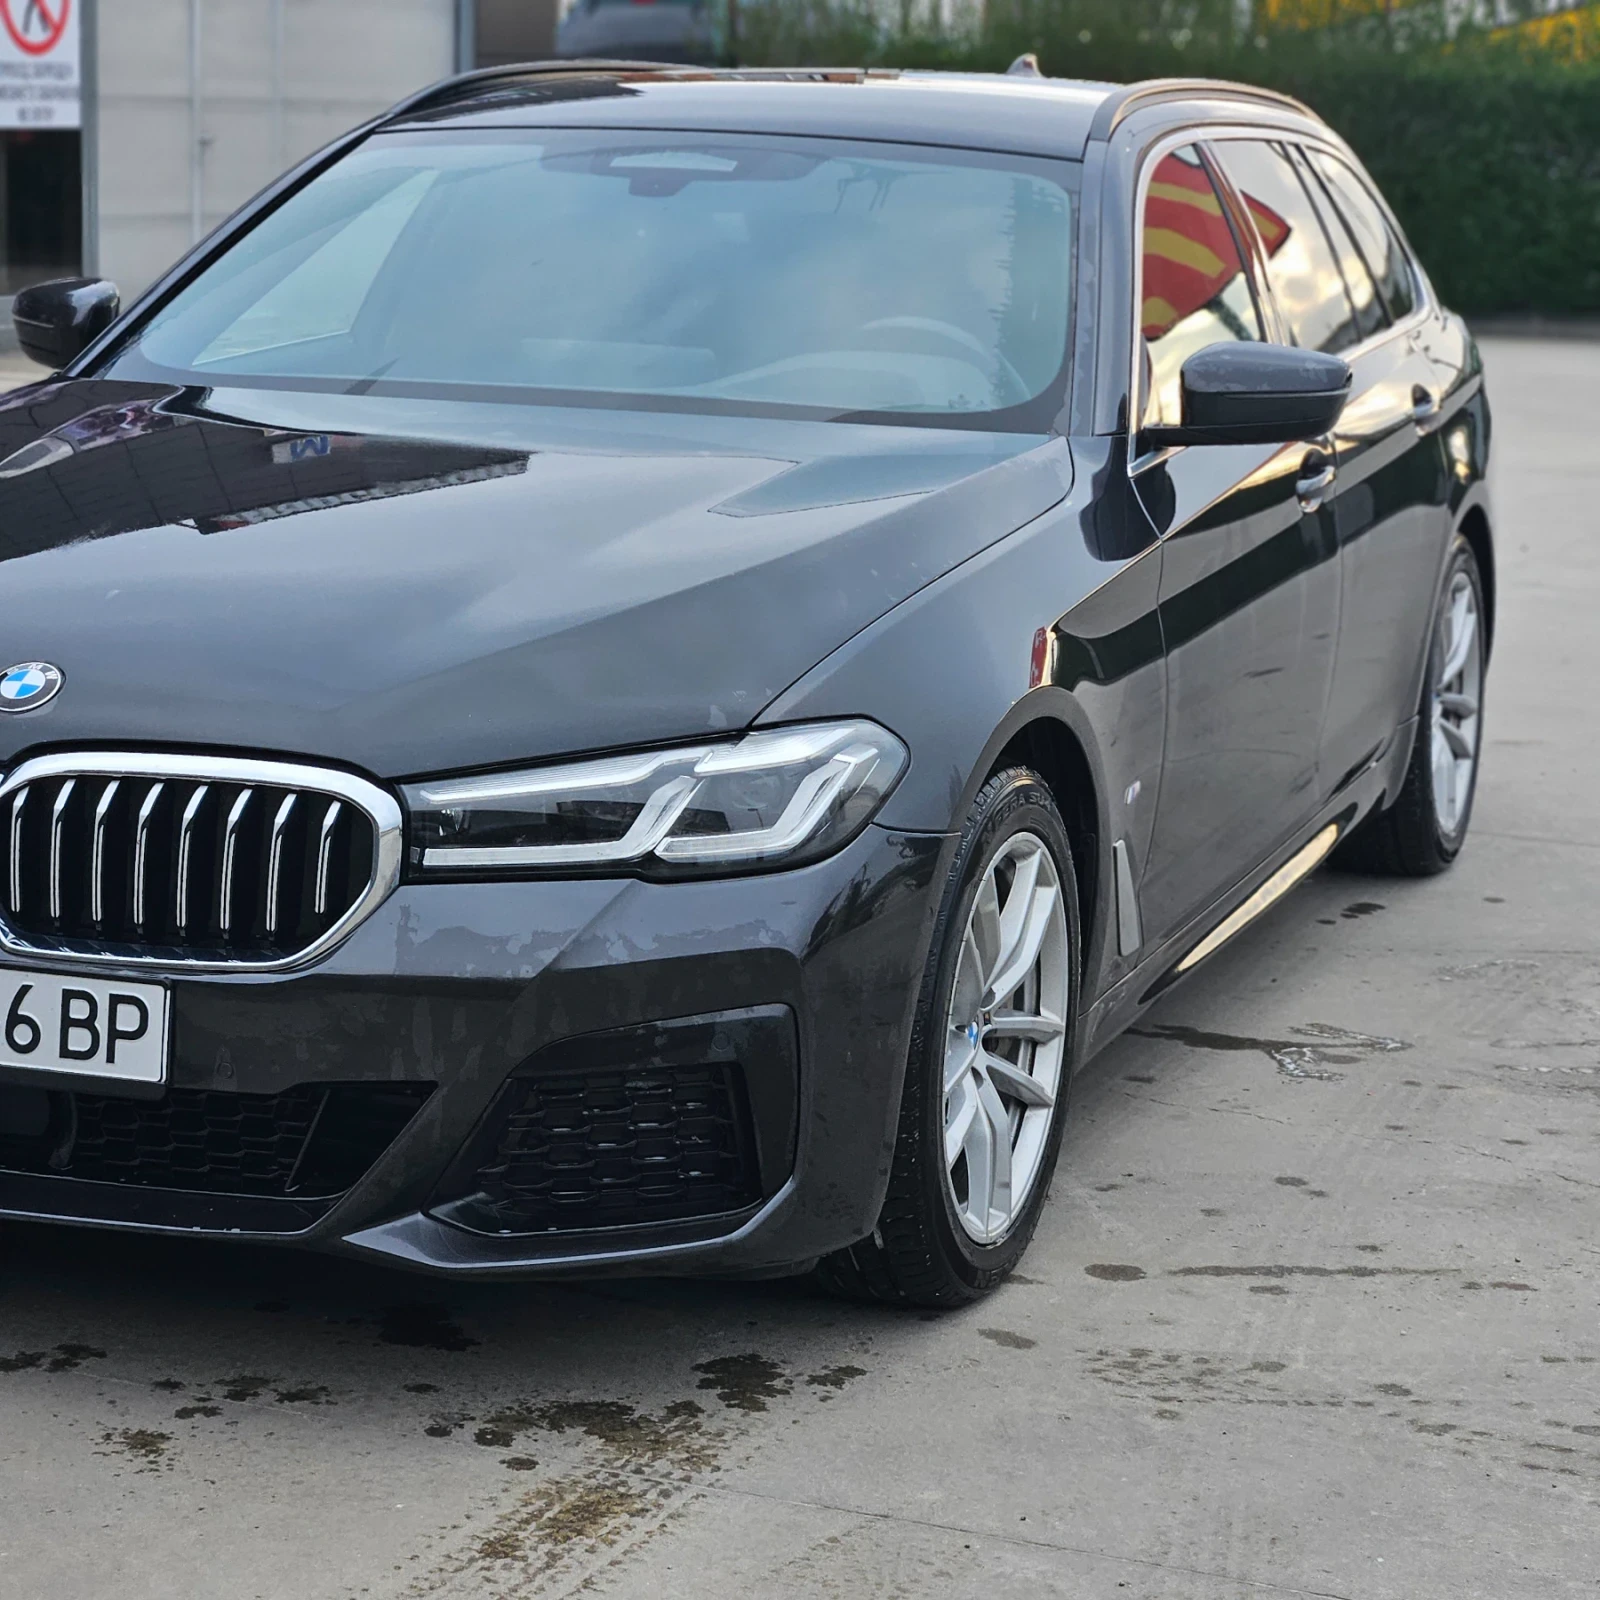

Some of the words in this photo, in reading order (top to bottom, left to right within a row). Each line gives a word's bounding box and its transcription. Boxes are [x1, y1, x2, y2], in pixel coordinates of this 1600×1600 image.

[7, 664, 58, 679] BMW
[5, 984, 41, 1054] 6
[59, 988, 149, 1064] BP
